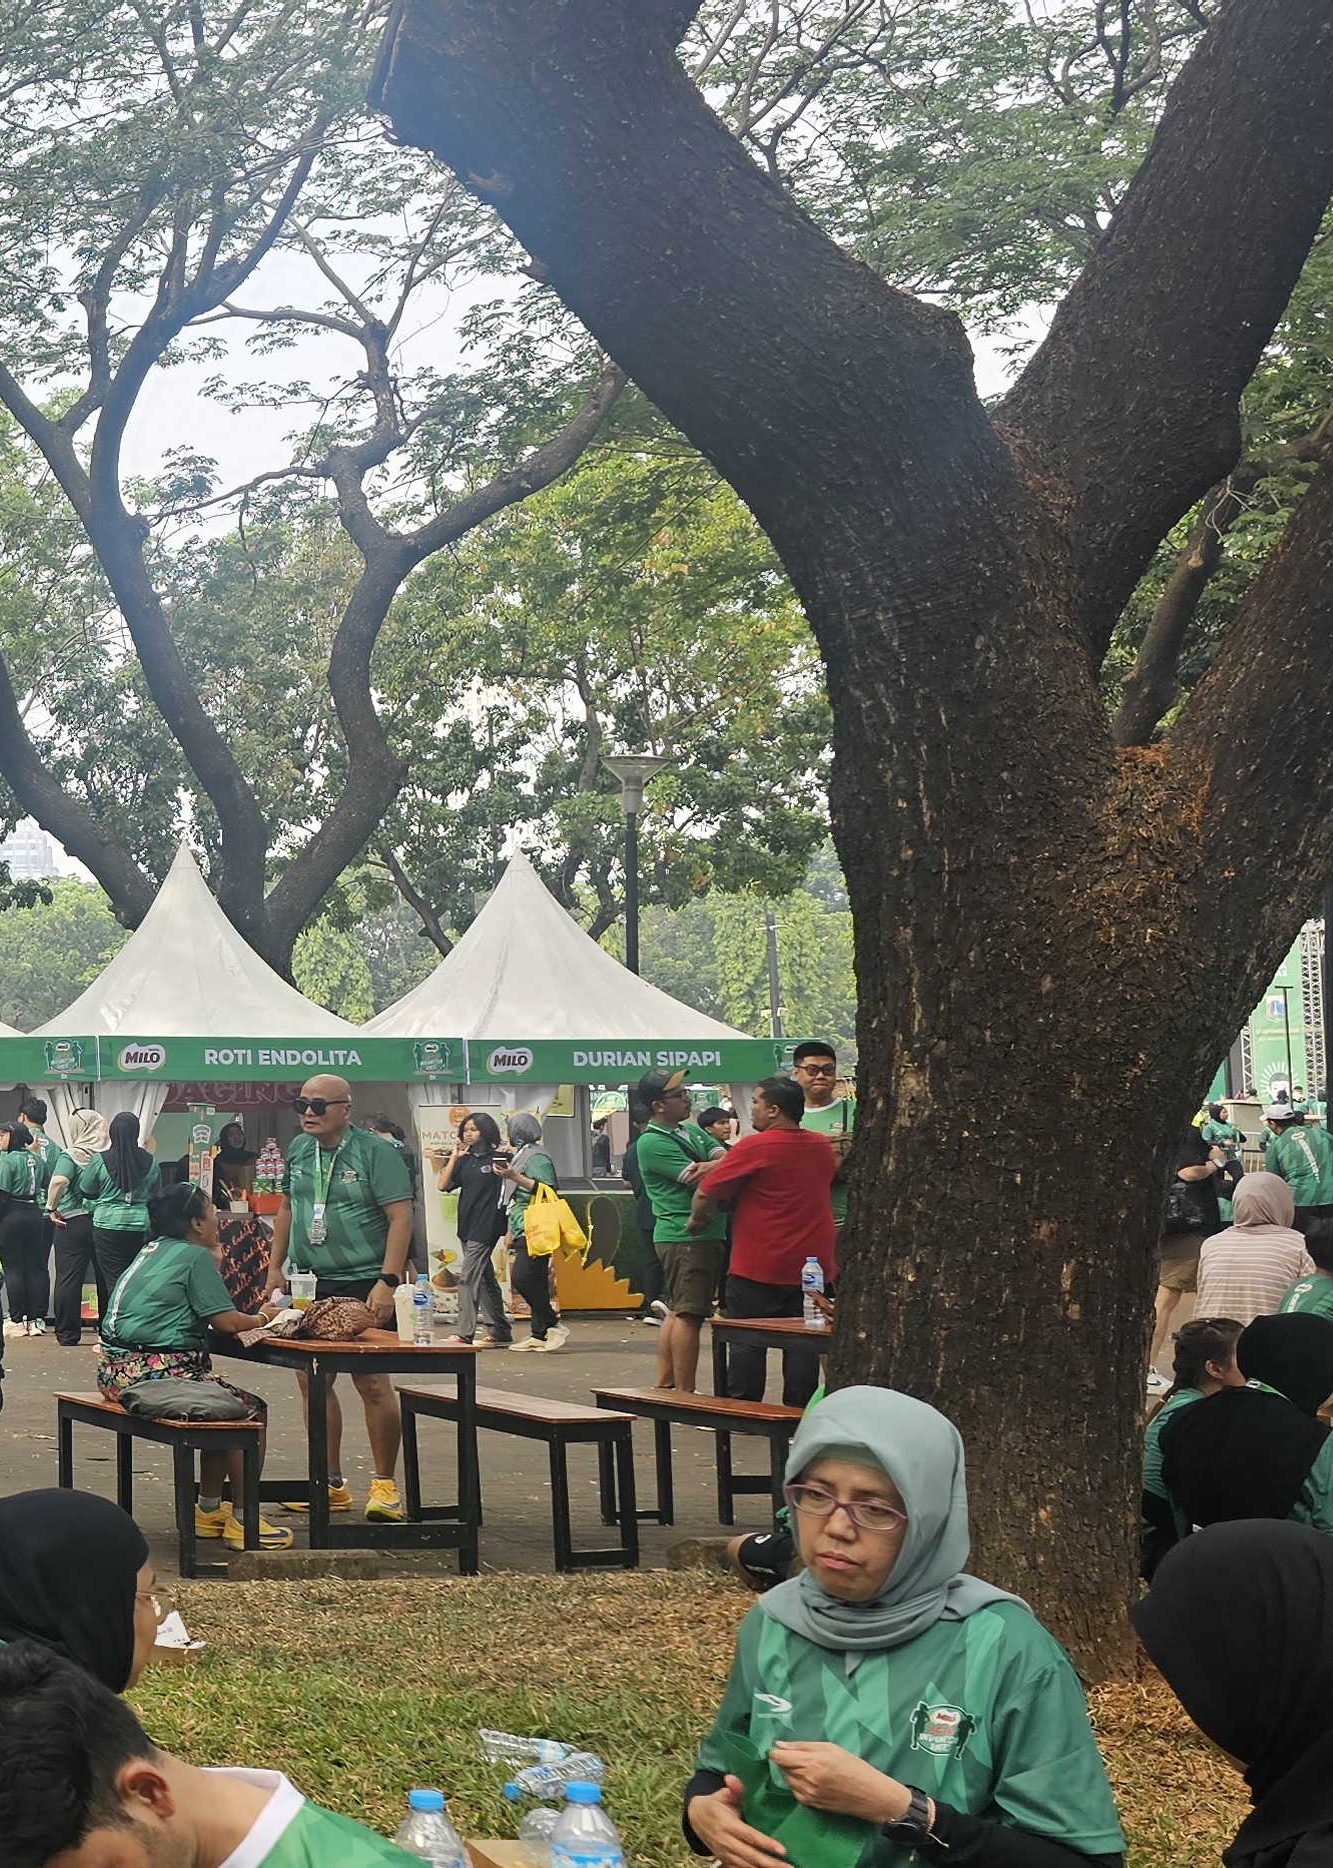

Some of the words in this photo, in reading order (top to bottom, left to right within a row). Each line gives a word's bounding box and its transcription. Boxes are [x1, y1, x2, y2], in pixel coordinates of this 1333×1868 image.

[123, 1051, 161, 1064] MILO
[204, 1049, 253, 1066] ROTI
[258, 1049, 362, 1066] ENDOLITA
[493, 1054, 529, 1068] MILO
[572, 1051, 651, 1067] DURIAN
[656, 1051, 721, 1067] SIPAPI
[421, 1130, 457, 1141] MATC
